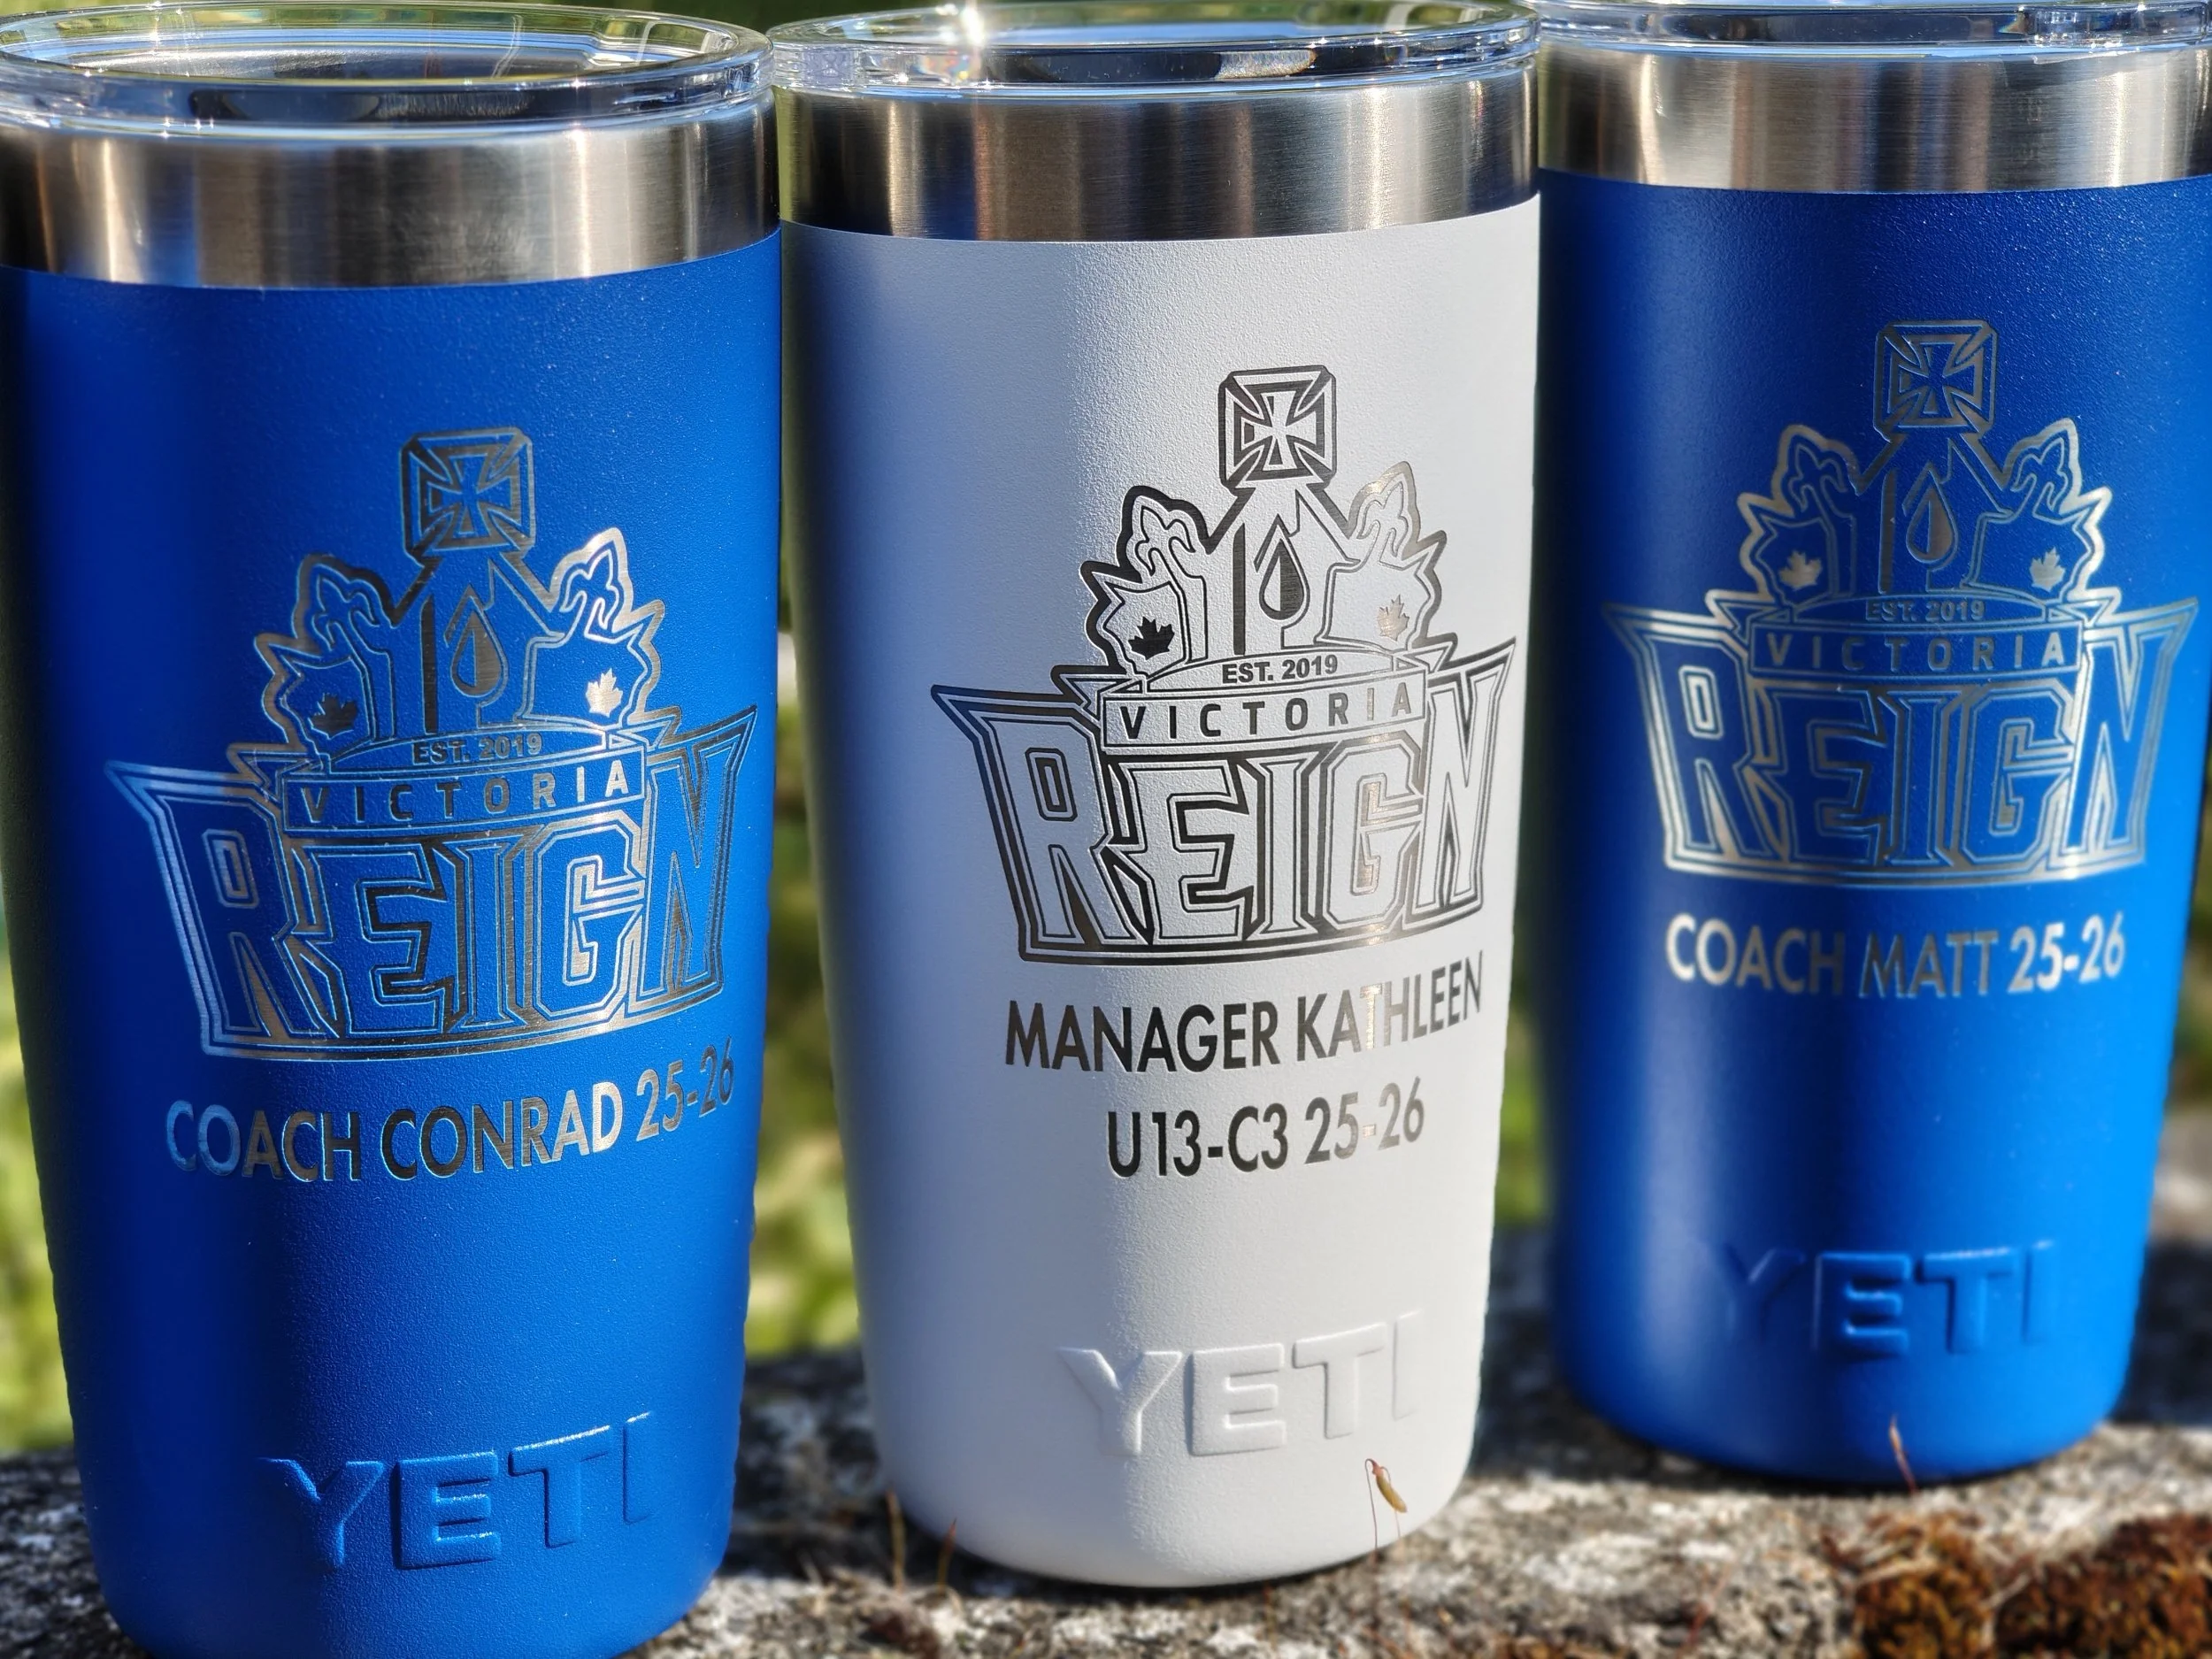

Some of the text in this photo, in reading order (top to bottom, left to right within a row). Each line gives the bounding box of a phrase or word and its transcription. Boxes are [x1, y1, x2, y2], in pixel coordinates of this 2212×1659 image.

[1768, 634, 2066, 672] VICTORIA
[1864, 599, 1986, 621] EST. 2019
[1119, 681, 1414, 741] VICTORIA
[1221, 653, 1339, 685] EST. 2019
[302, 758, 630, 823] VICTORIA
[412, 733, 543, 764] EST. 2019
[1606, 600, 2193, 881] REIGN
[934, 641, 1514, 961] REIGN
[110, 708, 755, 1055] REIGN
[1665, 911, 2125, 999] COACH MATT 25-26
[1005, 950, 1485, 1073] MANAGER KATHLEEN
[165, 1036, 734, 1183] COACH CONRAD 25-26
[1107, 1076, 1425, 1178] U13-C3 25-26
[1722, 1240, 2058, 1361] YETI
[1060, 1310, 1423, 1457] YETI
[263, 1411, 657, 1571] YETI
